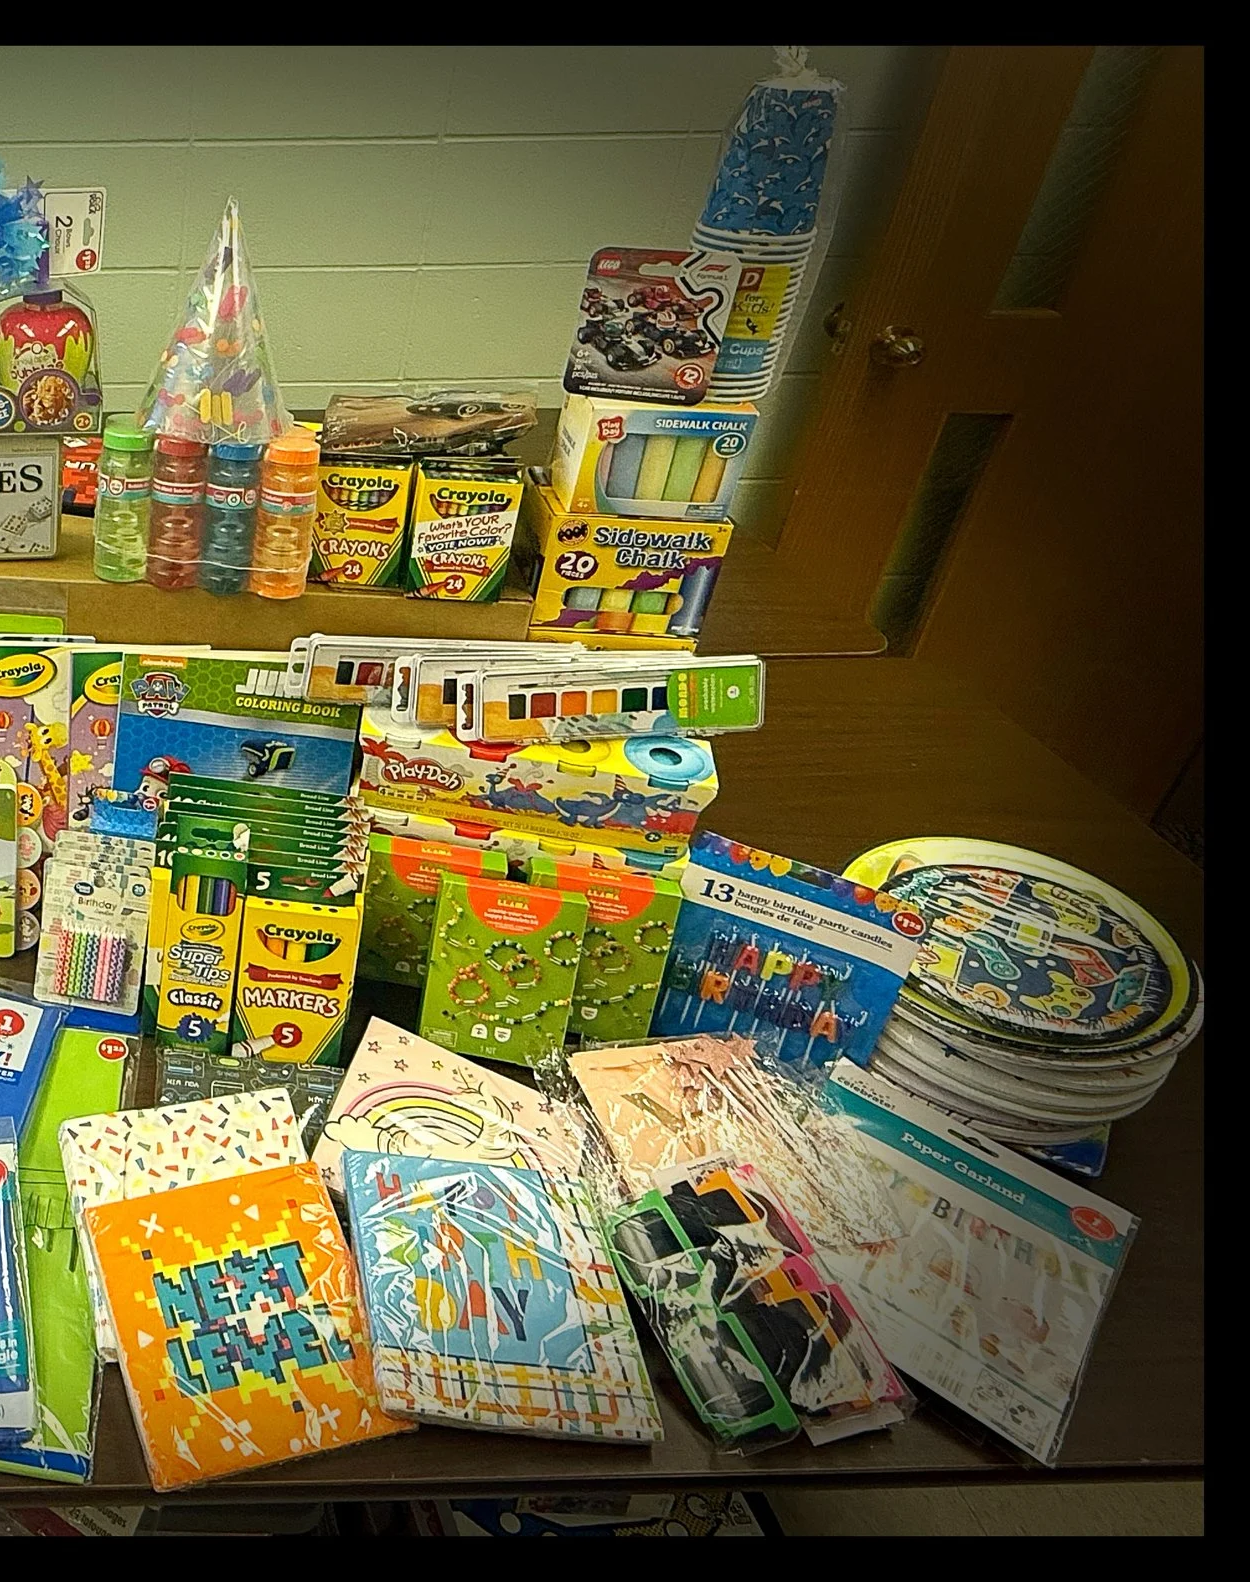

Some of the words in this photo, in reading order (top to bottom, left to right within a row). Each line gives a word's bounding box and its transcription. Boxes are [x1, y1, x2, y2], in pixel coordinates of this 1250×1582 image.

[656, 419, 709, 430] SIDEWALK
[712, 420, 747, 431] CHALK
[721, 438, 739, 448] 20
[328, 473, 394, 491] Crayola
[437, 488, 506, 504] Crayola
[418, 527, 468, 543] Favorite
[470, 523, 512, 538] Color?
[429, 518, 462, 533] What's
[465, 514, 499, 528] YOUR
[428, 541, 454, 552] VOTE
[458, 538, 493, 548] NOW!
[593, 527, 713, 551] Sidewalk
[319, 539, 389, 560] CRAYONS
[615, 548, 686, 569] Chalk
[432, 552, 486, 567] CRAYONS
[560, 553, 595, 572] 20
[344, 564, 361, 576] 24
[446, 579, 463, 590] 24
[130, 679, 191, 702] PAW
[143, 702, 173, 710] PATROL
[236, 697, 299, 713] COLORING
[303, 704, 340, 718] BOOK
[386, 762, 460, 790] Play-Doh
[256, 872, 271, 890] 5
[699, 878, 734, 903] 13
[737, 889, 770, 906] happy
[772, 899, 817, 922] birthday
[819, 916, 849, 935] party
[850, 928, 893, 949] candles
[734, 899, 774, 920] bougies
[776, 913, 790, 923] de
[791, 918, 813, 931] fête
[188, 924, 216, 932] Crayola
[264, 923, 333, 943] Crayola
[169, 945, 223, 966] Super
[194, 963, 231, 981] Tips
[170, 990, 221, 1010] Classic
[244, 988, 339, 1018] MARKERS
[0, 1015, 14, 1030] 1
[188, 1020, 201, 1037] 5
[281, 1027, 295, 1043] 5
[837, 1076, 895, 1110] celebrate!
[901, 1132, 951, 1165] Paper
[954, 1161, 1026, 1206] Garland
[153, 1240, 313, 1329] NEXT
[414, 1277, 528, 1341] DAY
[7, 1338, 17, 1349] in
[166, 1303, 356, 1398] LEVEL
